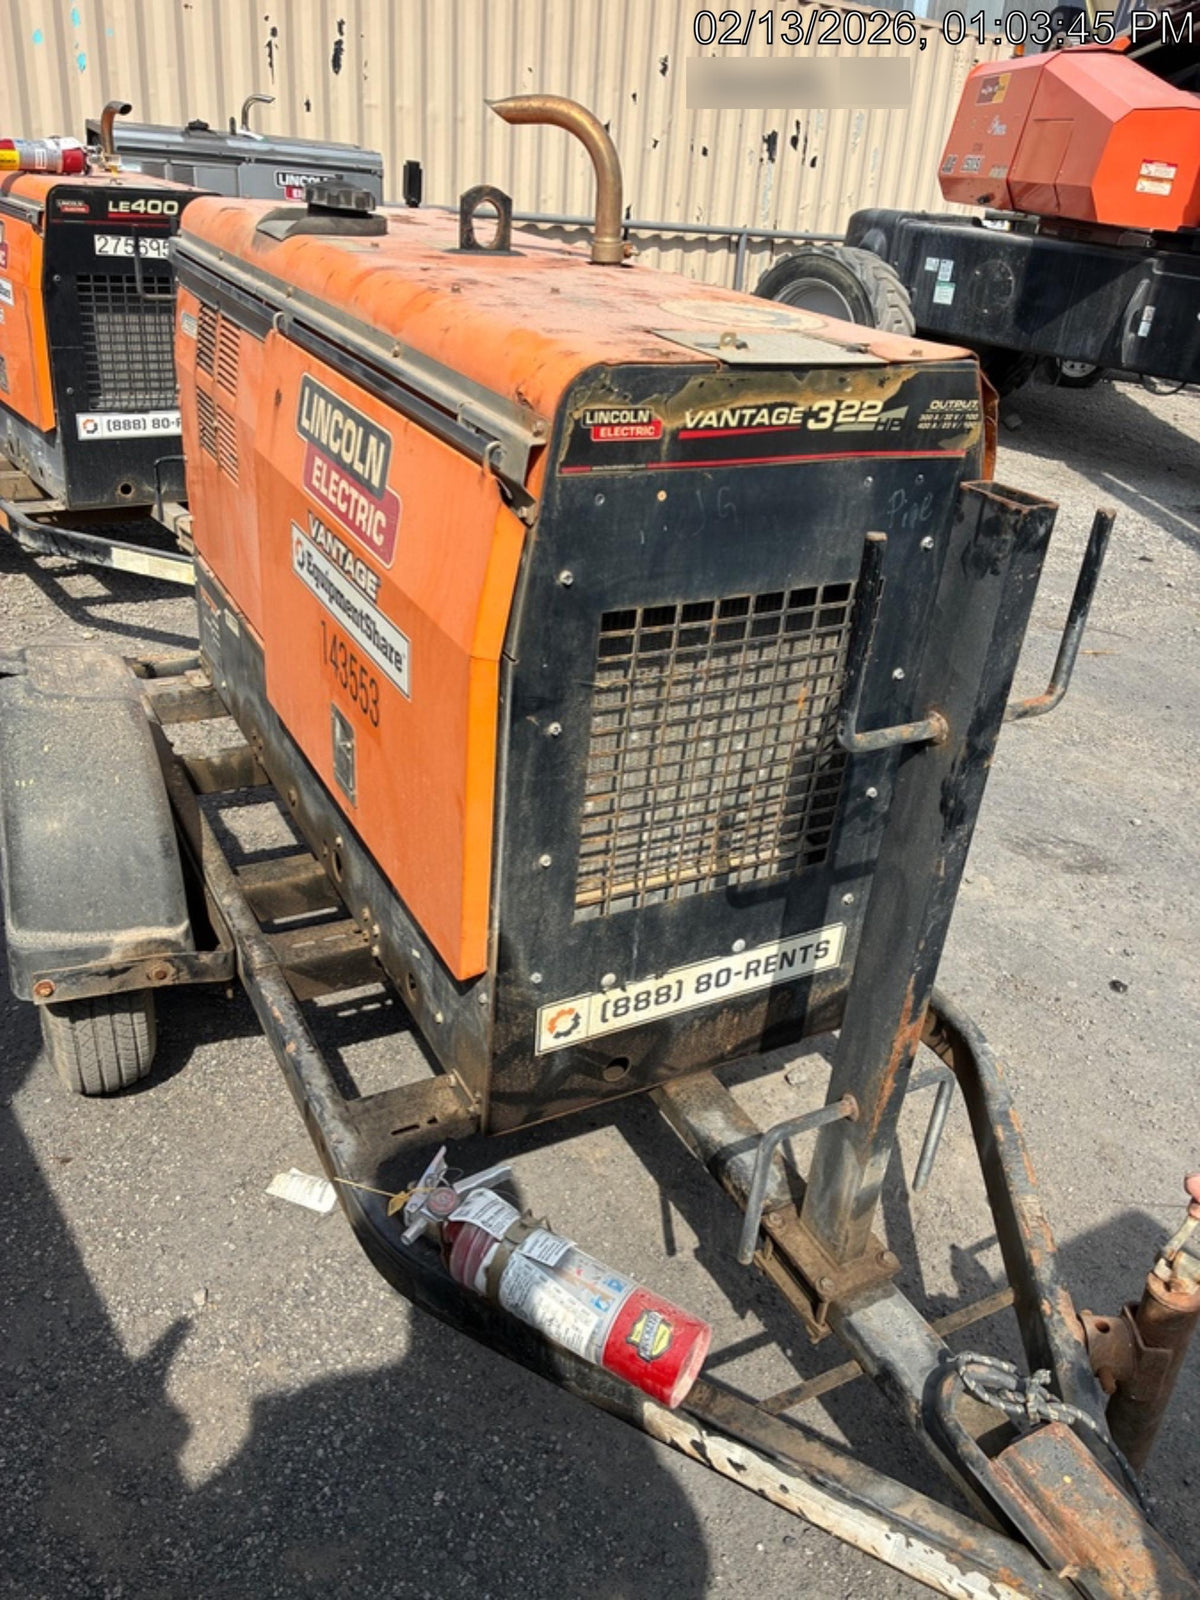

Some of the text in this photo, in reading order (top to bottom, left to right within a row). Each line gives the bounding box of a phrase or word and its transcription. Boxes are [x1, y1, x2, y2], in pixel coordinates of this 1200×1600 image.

[108, 199, 179, 215] LE400
[106, 417, 147, 432] (888)
[585, 409, 650, 425] LINCOLN
[598, 425, 656, 439] ELECTRIC
[684, 406, 805, 430] VANTAGE
[807, 400, 885, 430] 322
[929, 400, 980, 410] OUTPUT
[300, 386, 386, 489] LINCOLN
[311, 455, 387, 546] ELECTRIC
[308, 511, 381, 602] VANTAGE
[304, 549, 404, 674] EquipmentShare
[320, 620, 381, 728] 143553
[600, 939, 831, 1022] (888) 80-RENTS
